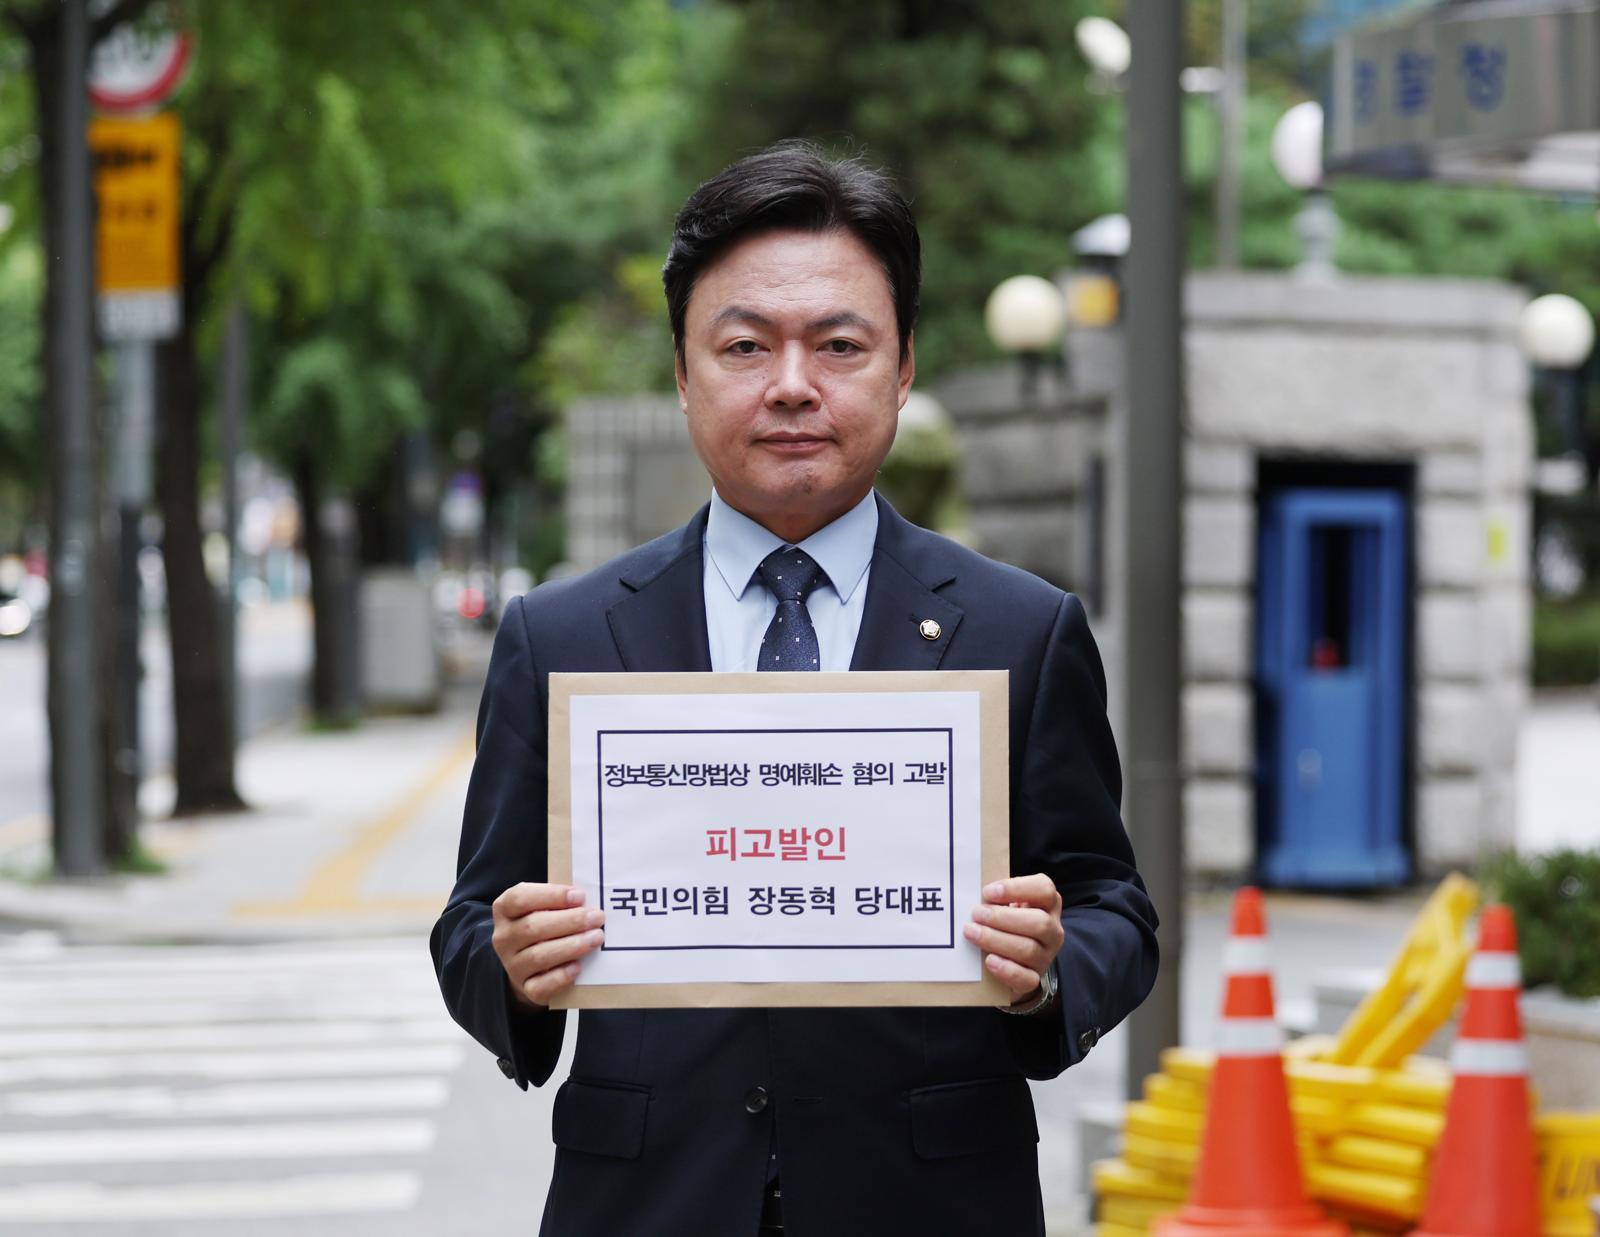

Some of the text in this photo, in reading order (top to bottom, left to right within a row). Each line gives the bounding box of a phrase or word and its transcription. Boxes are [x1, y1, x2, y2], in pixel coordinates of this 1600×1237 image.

[604, 763, 750, 788] 정보통신망법상
[852, 762, 895, 786] 혐의
[903, 762, 947, 785] 고발
[705, 827, 847, 861] 피고발인
[609, 886, 945, 916] 국민의힘 장동혁 당대표
